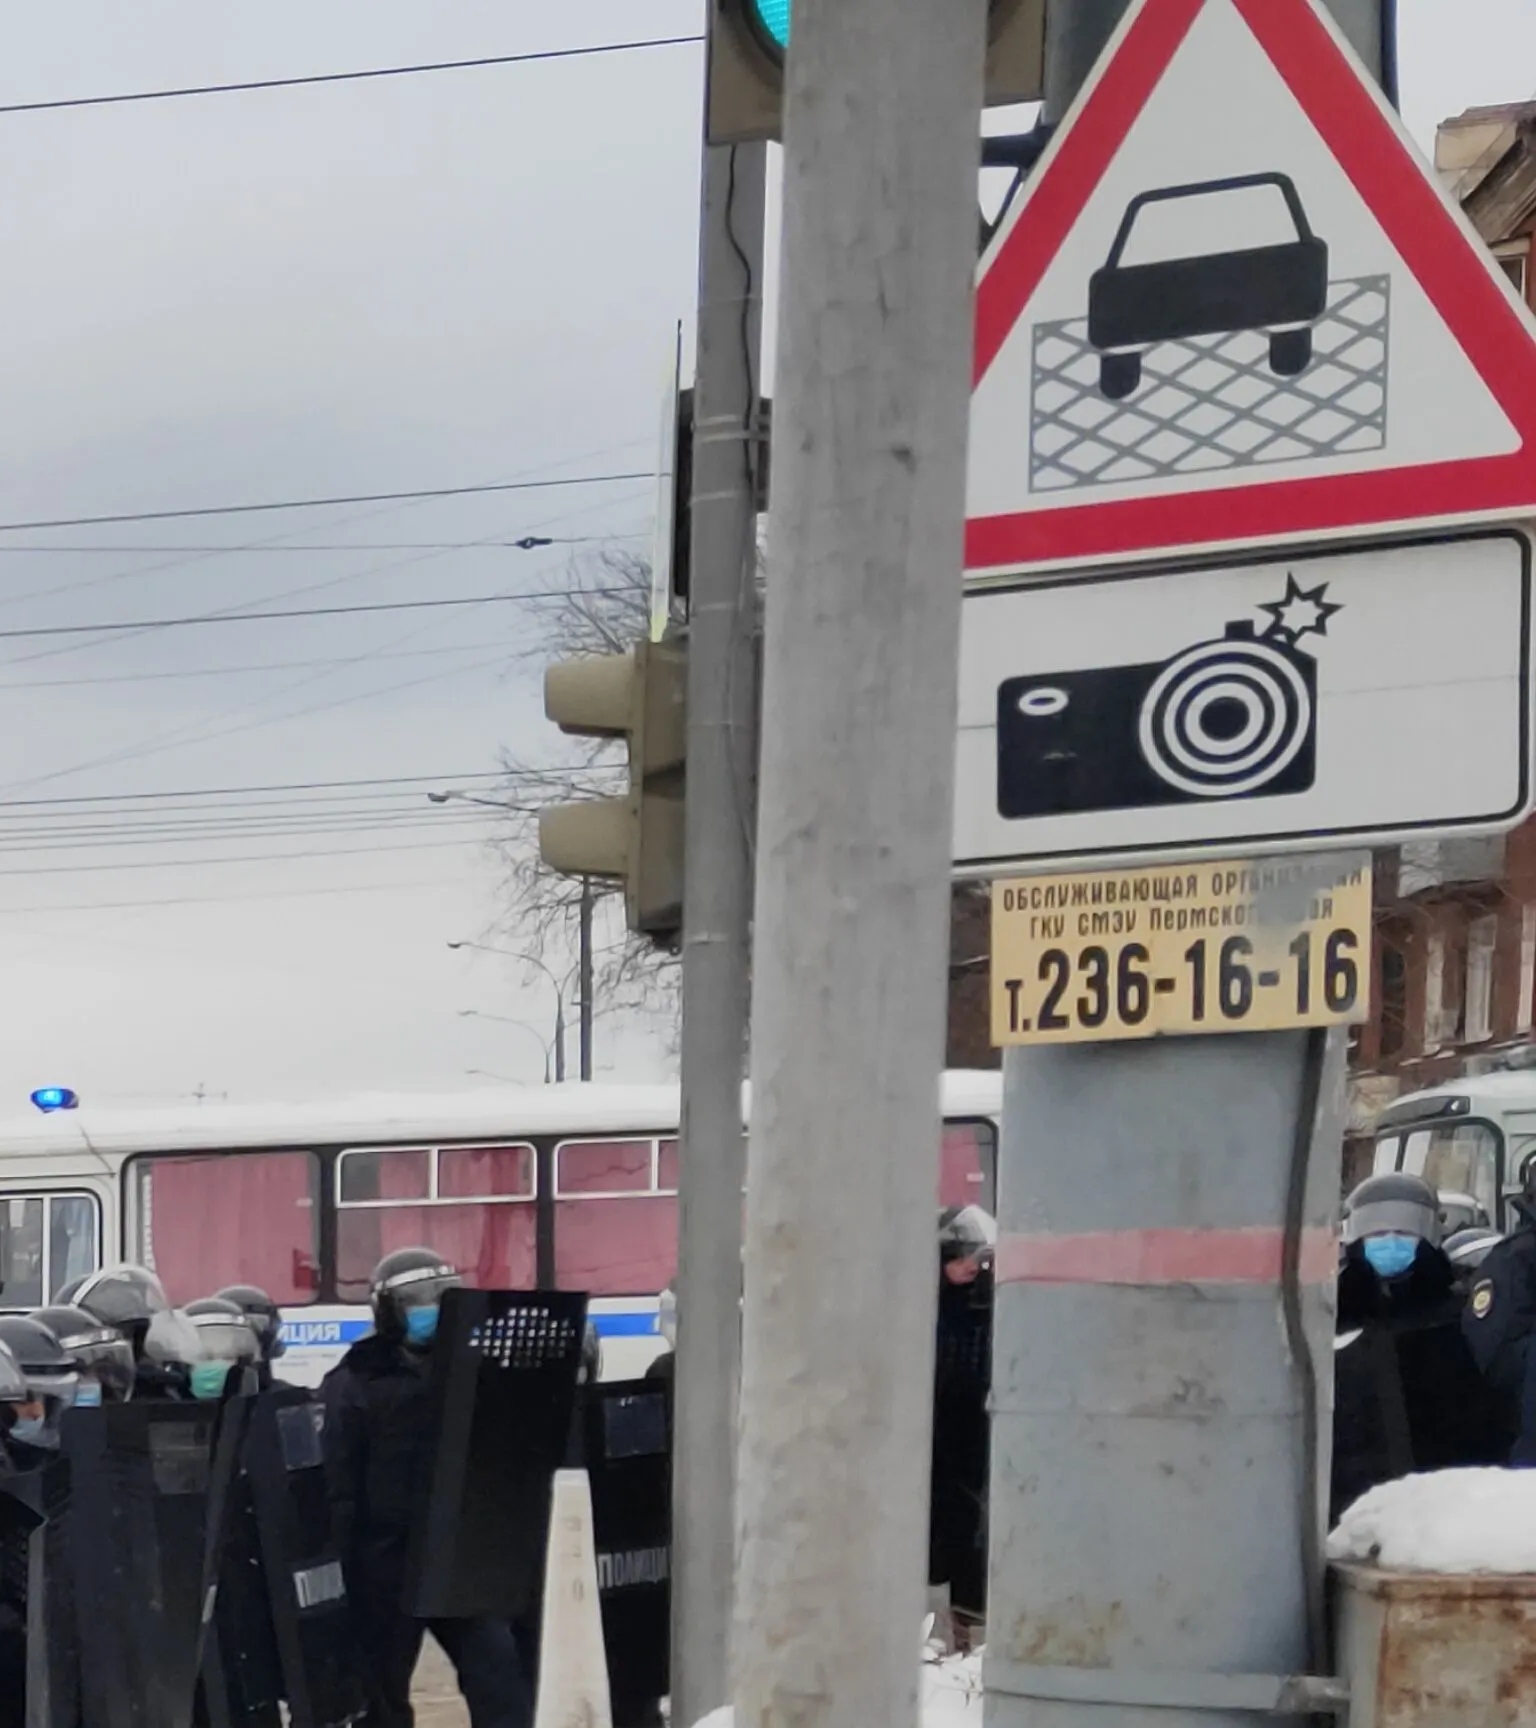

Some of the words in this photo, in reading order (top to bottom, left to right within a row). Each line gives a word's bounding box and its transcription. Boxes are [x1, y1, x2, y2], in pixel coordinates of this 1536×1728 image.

[1003, 873, 1198, 912] ОБСЛУЖИВАЮЩАЯ
[1211, 863, 1362, 897] ОРГАНИИЯ
[1030, 914, 1065, 940] ГКУ
[1078, 909, 1137, 936] СМЭУ
[1150, 904, 1256, 930] Пермског
